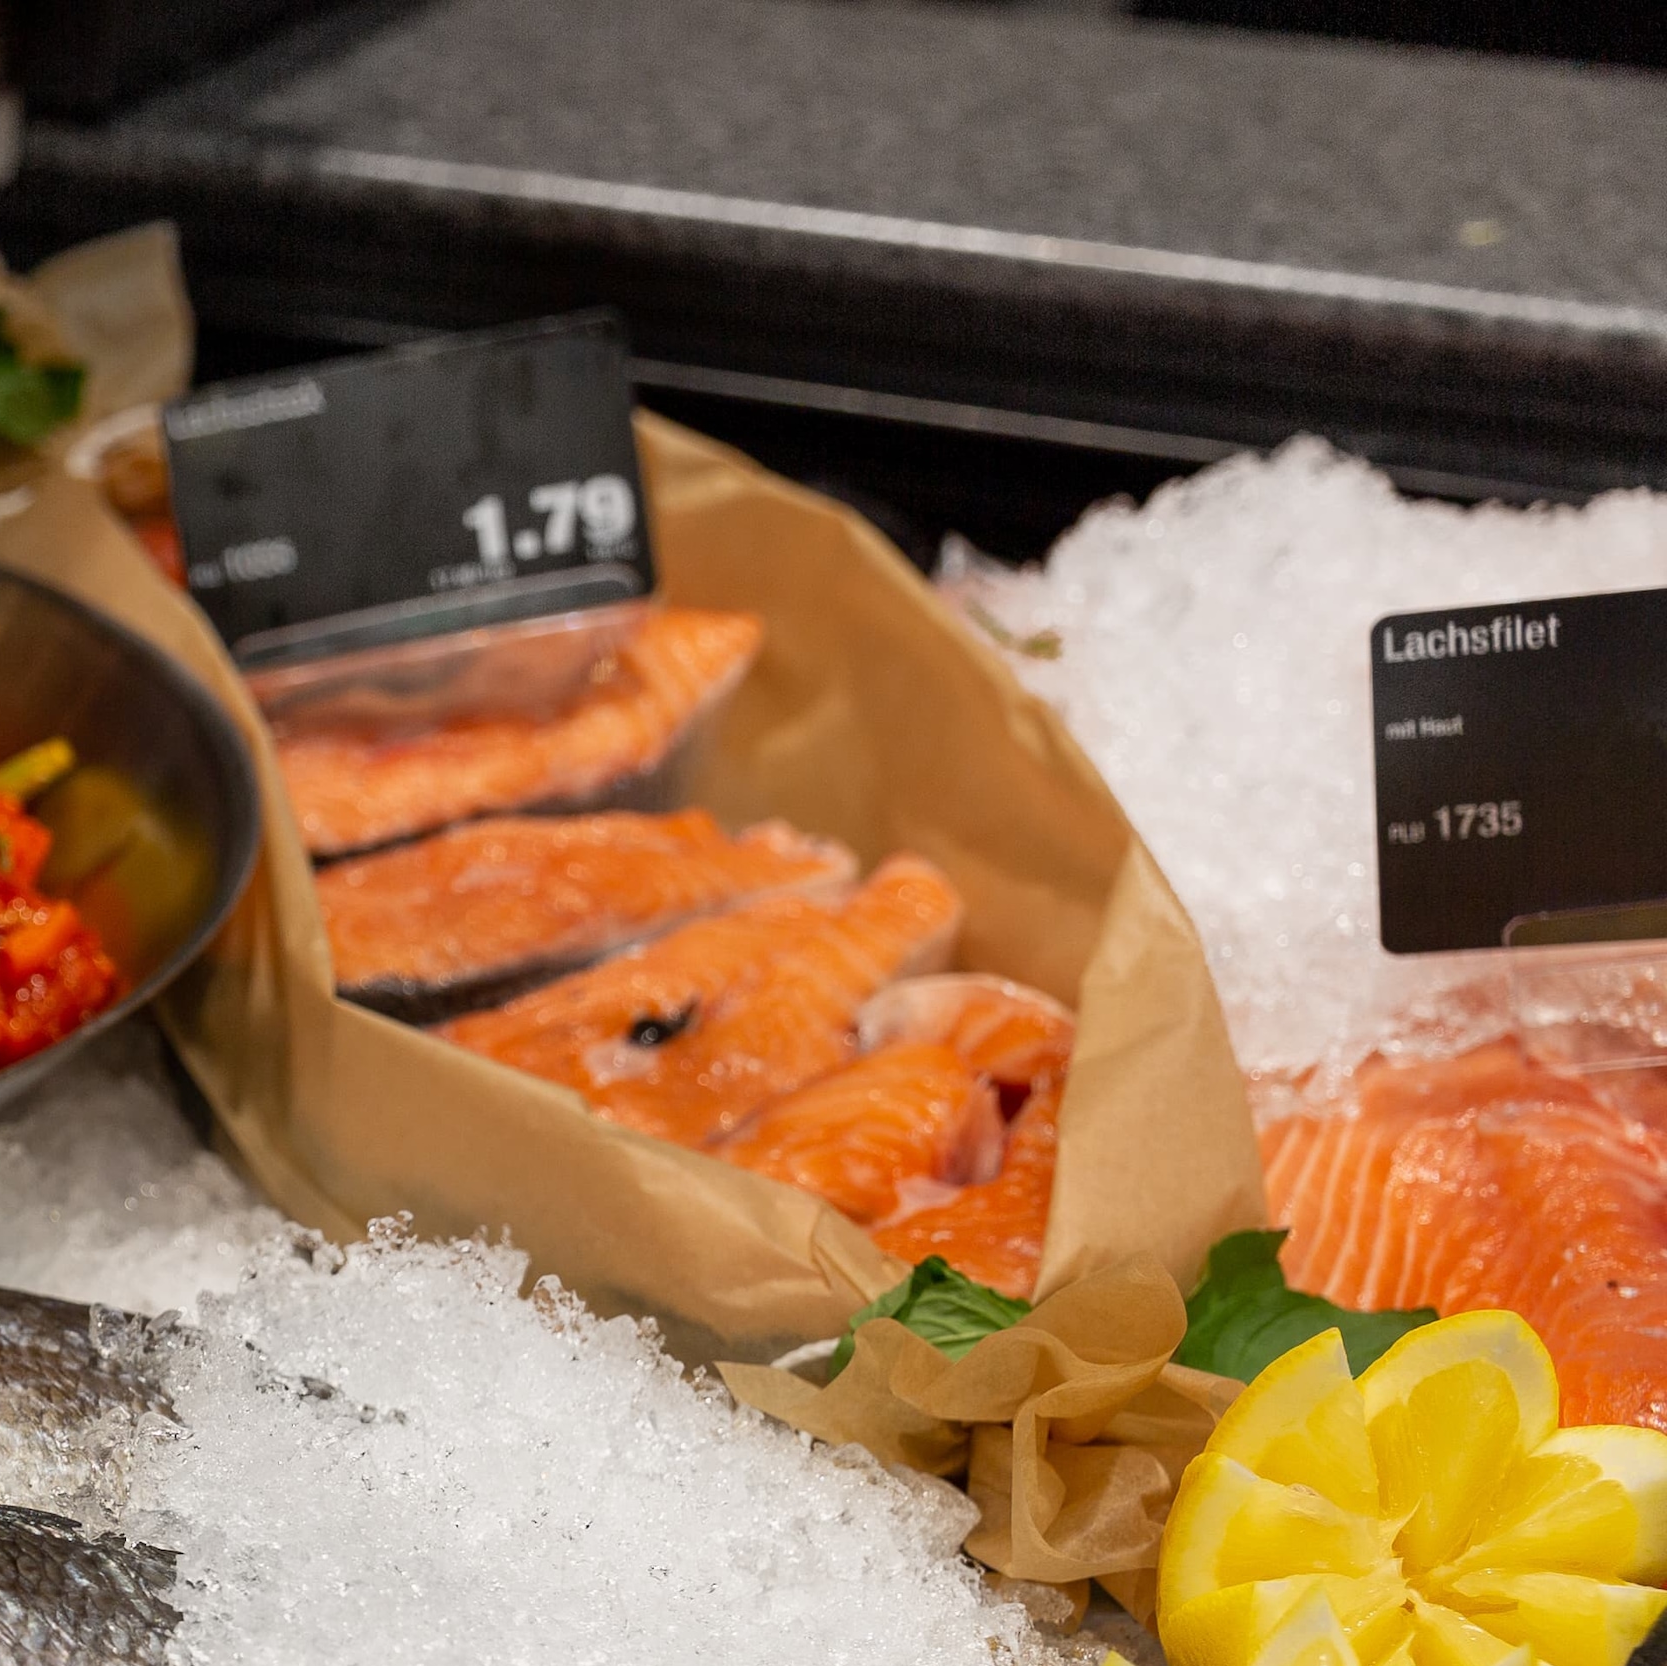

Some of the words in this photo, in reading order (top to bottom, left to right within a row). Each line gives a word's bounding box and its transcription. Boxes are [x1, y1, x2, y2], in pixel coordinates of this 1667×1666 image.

[462, 474, 636, 563] 1.79
[1382, 612, 1561, 664] Lachsfilet
[1433, 800, 1524, 841] 1735
